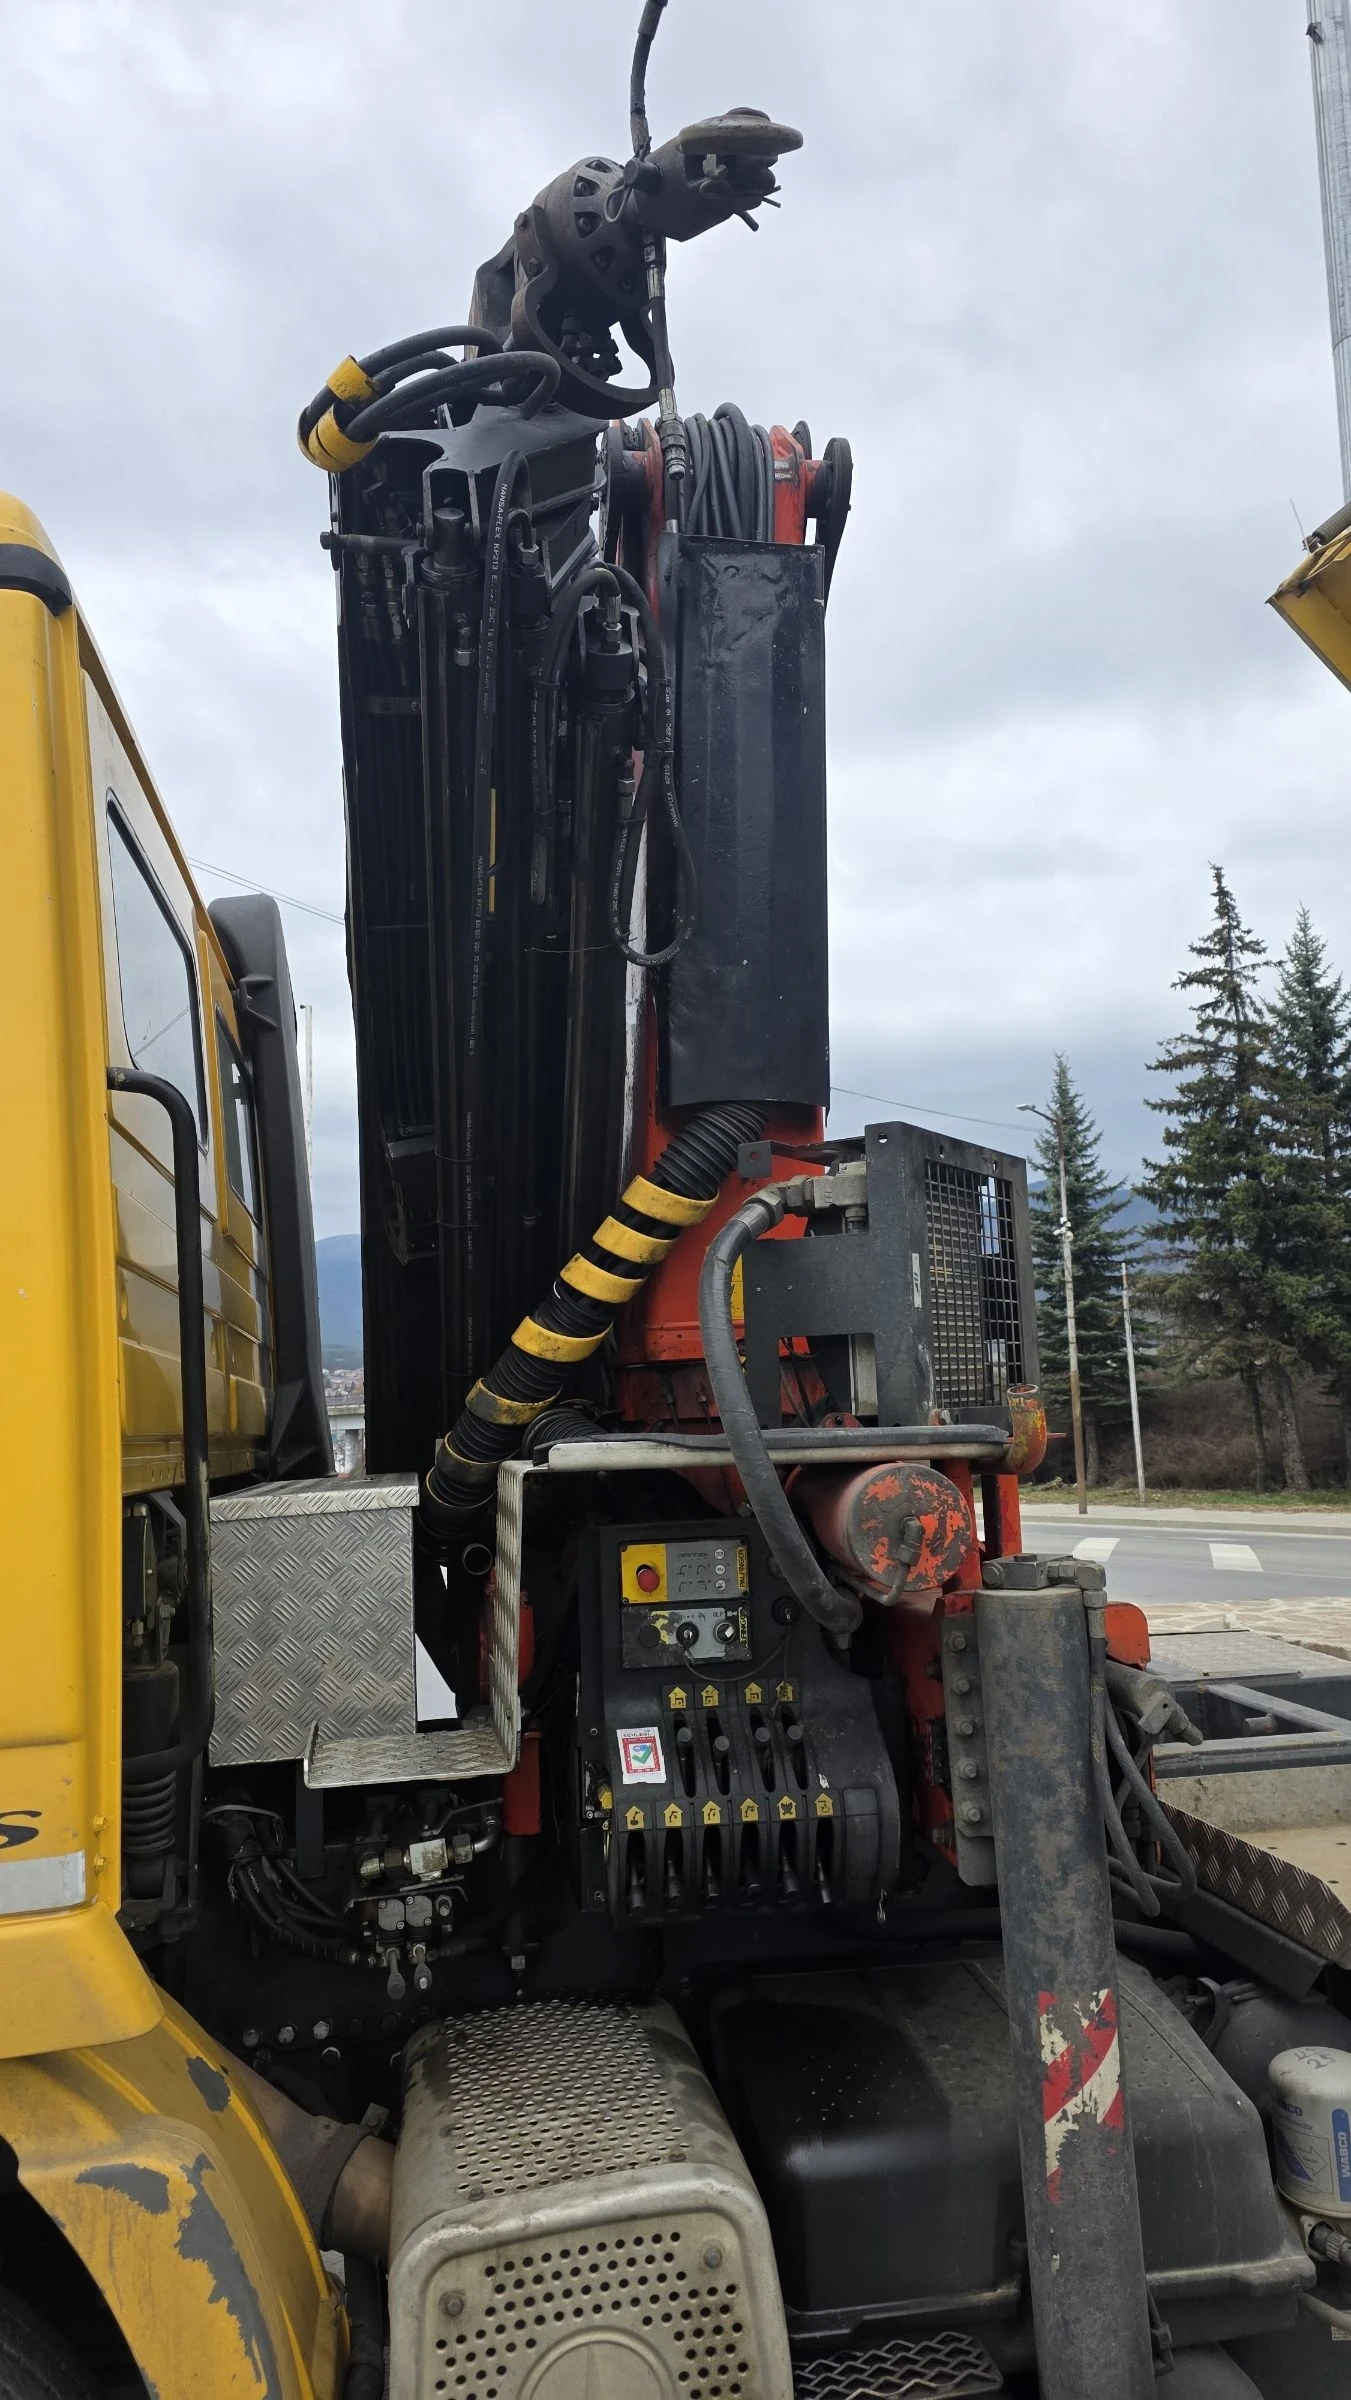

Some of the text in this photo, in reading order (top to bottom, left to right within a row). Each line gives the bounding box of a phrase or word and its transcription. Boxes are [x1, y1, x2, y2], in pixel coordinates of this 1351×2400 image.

[494, 483, 509, 539] HANSA-FLEX
[492, 543, 501, 570] KP213
[664, 764, 672, 785] KP210
[667, 791, 680, 828] HANSA-FLEX
[615, 859, 623, 877] KP210
[1338, 2131, 1351, 2178] WABCO
